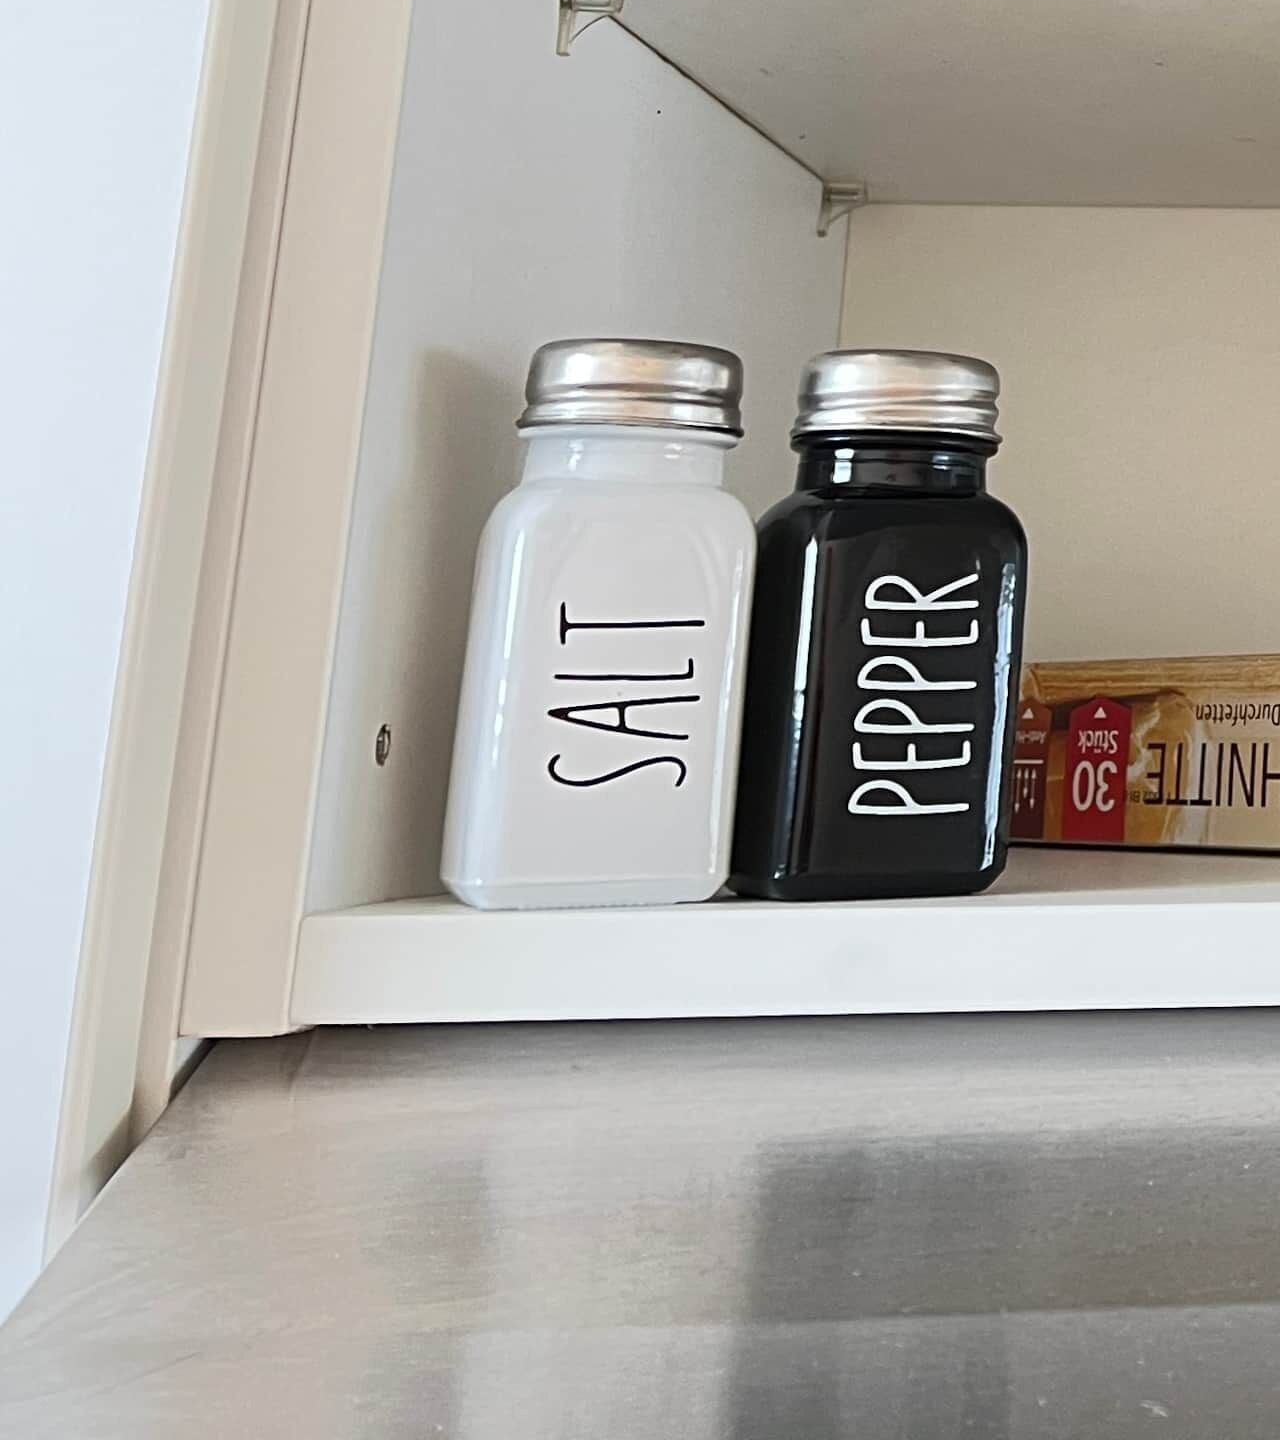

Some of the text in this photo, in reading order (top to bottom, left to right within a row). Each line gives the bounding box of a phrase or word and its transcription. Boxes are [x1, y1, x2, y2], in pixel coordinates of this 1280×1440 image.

[547, 601, 705, 789] SALT
[848, 573, 979, 816] PEPPER
[1196, 702, 1280, 727] Durchfetten
[1078, 729, 1119, 754] Stück
[1072, 760, 1118, 812] 30
